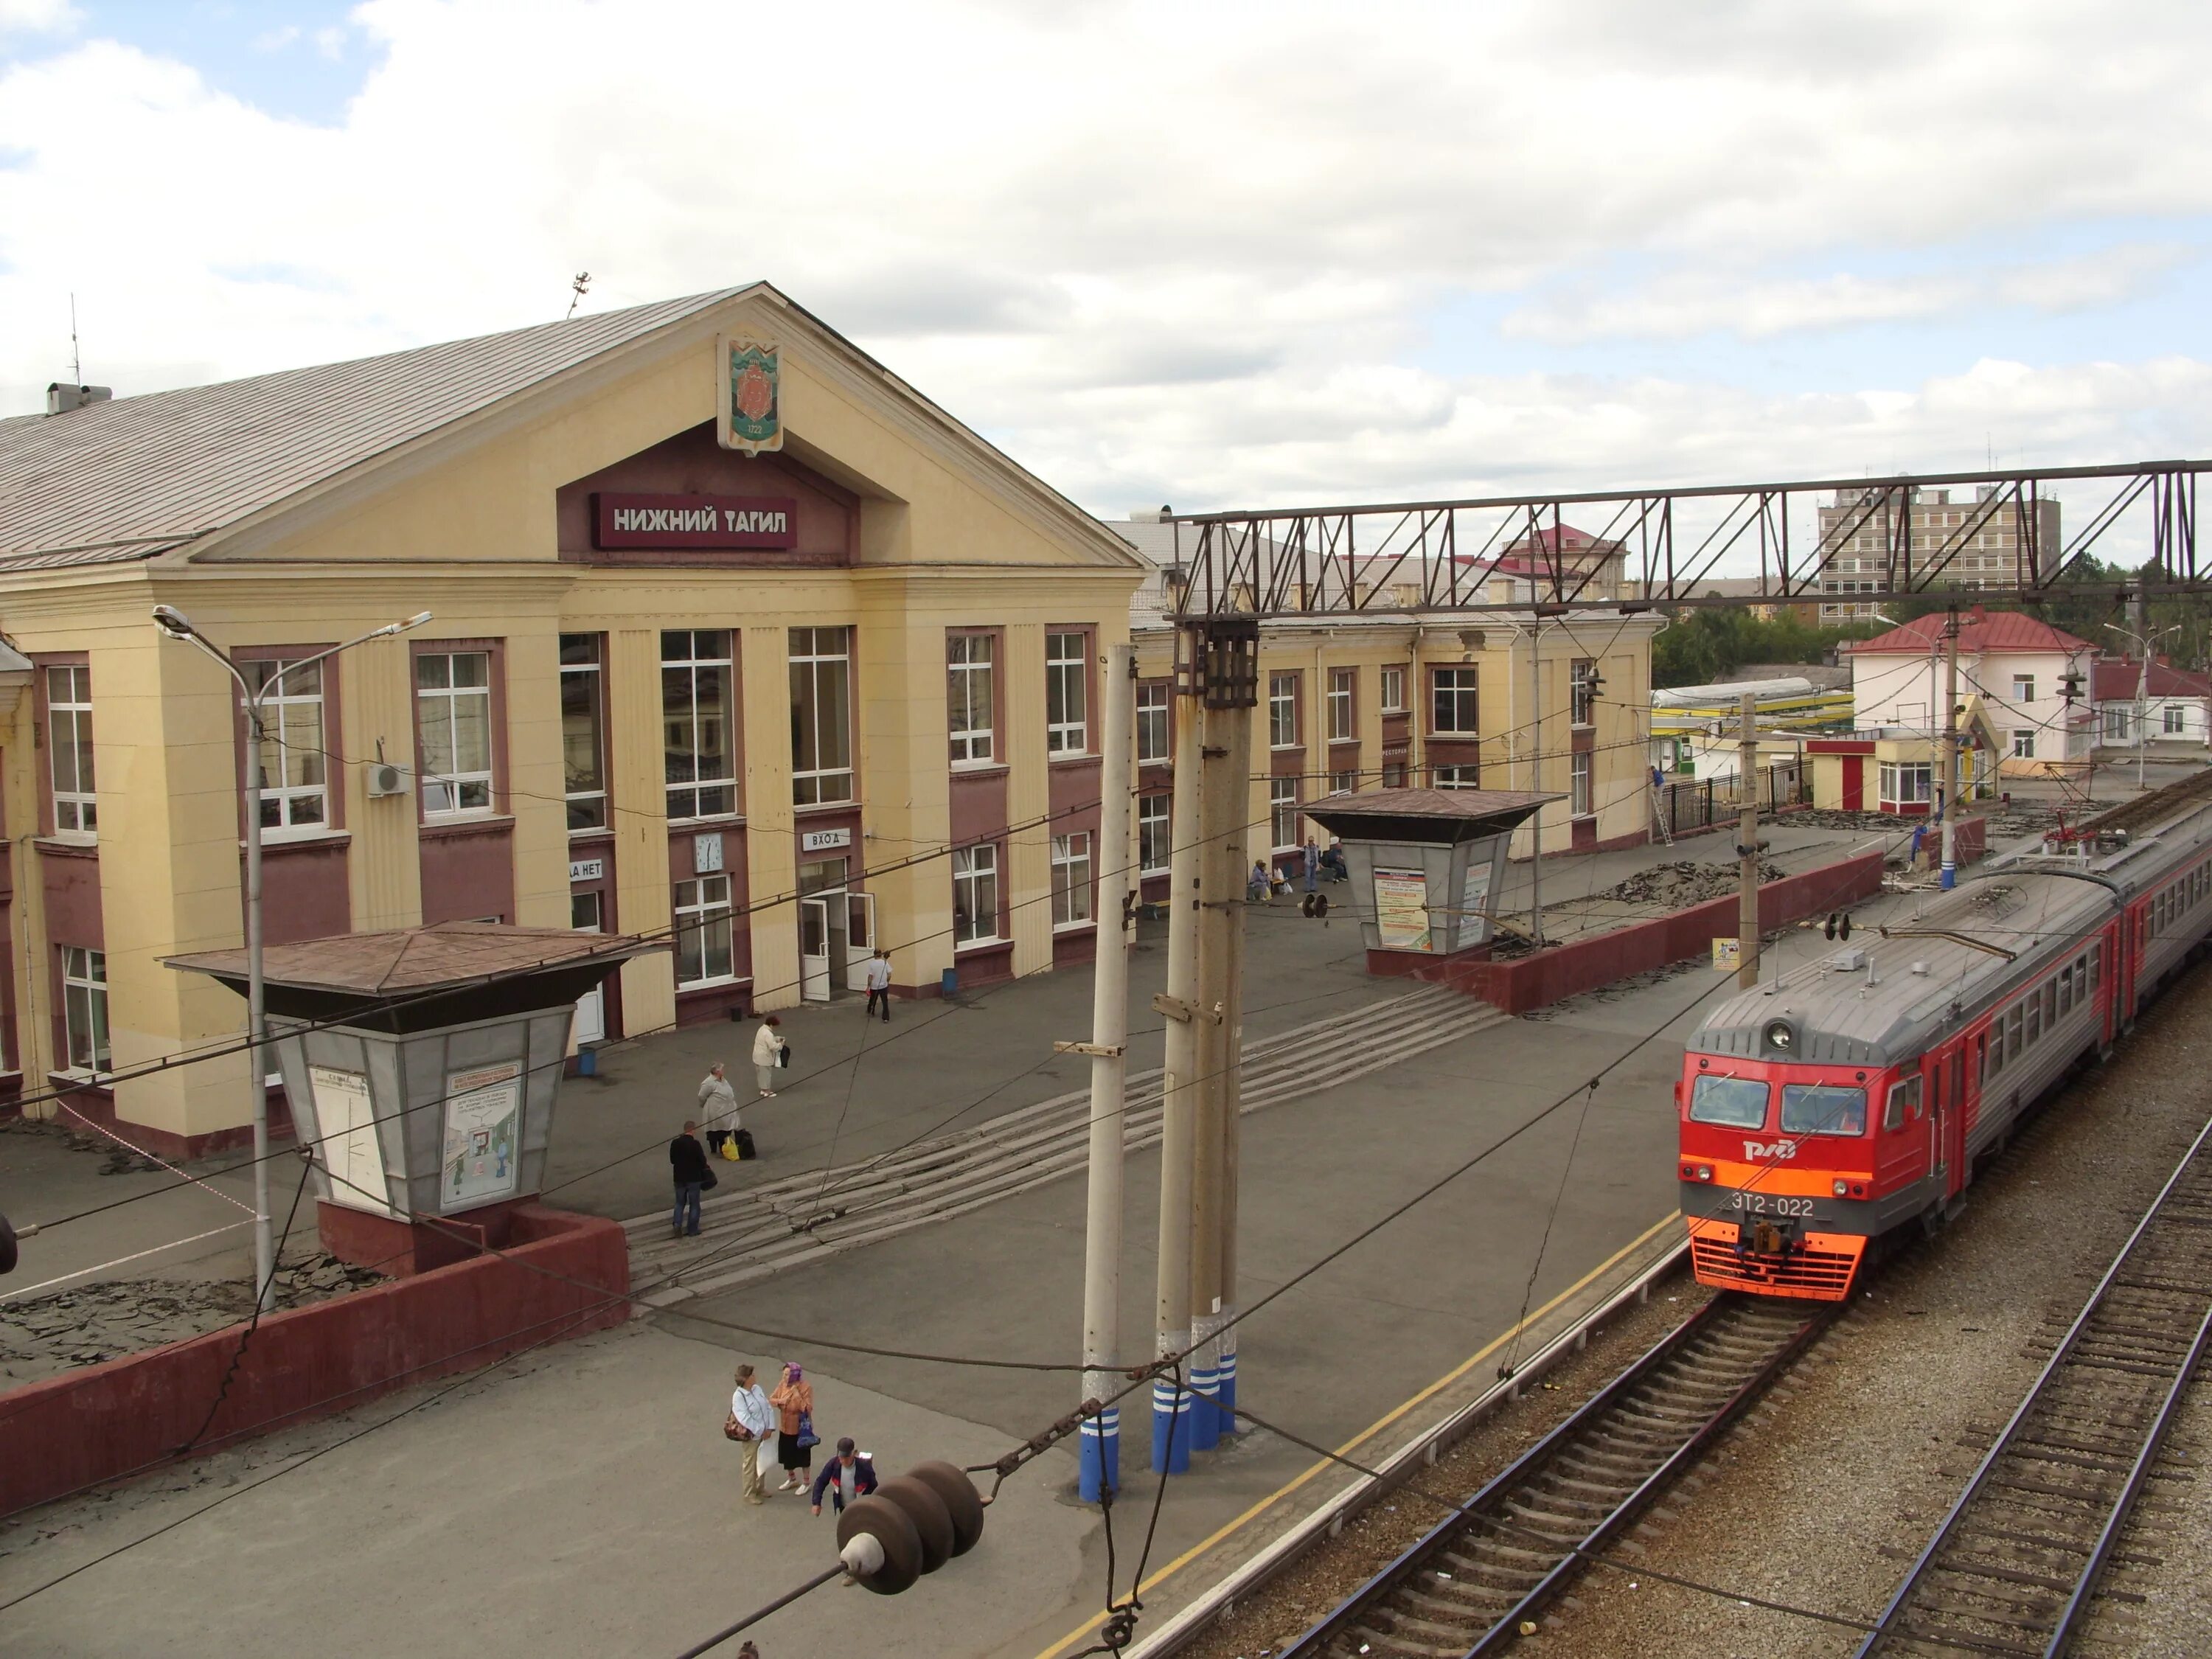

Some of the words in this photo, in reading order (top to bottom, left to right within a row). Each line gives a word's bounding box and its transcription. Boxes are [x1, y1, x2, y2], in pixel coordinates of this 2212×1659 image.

[748, 424, 762, 434] 1722
[613, 505, 717, 532] НИЖНИЙ
[724, 510, 787, 533] ТАГИЛ
[813, 832, 840, 846] ВХОД
[582, 863, 601, 875] НЕТ
[1742, 1139, 1796, 1161] РЖД
[1731, 1192, 1813, 1217] ЭТ2-022
